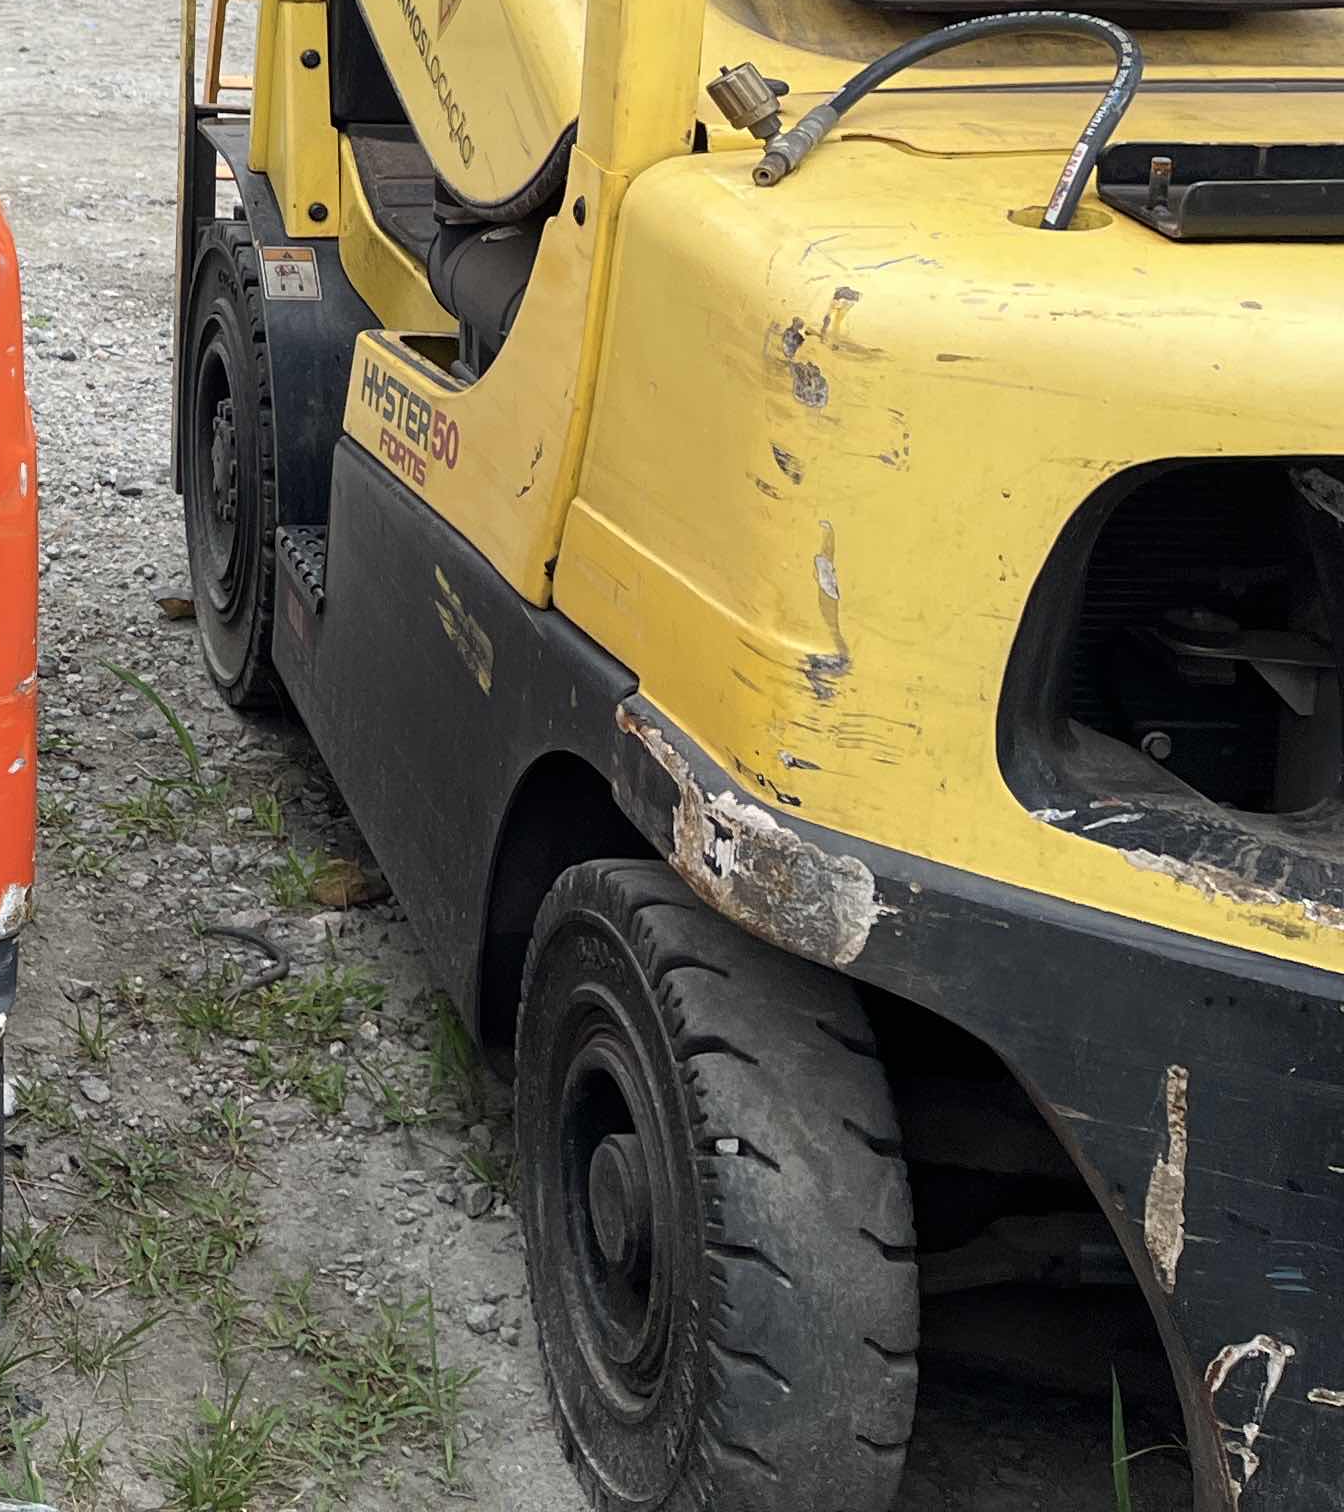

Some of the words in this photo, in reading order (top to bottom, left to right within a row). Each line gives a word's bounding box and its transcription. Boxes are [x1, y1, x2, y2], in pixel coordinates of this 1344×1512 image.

[361, 357, 432, 451] HYSTER
[431, 409, 460, 470] 50
[379, 427, 427, 487] FORTIS
